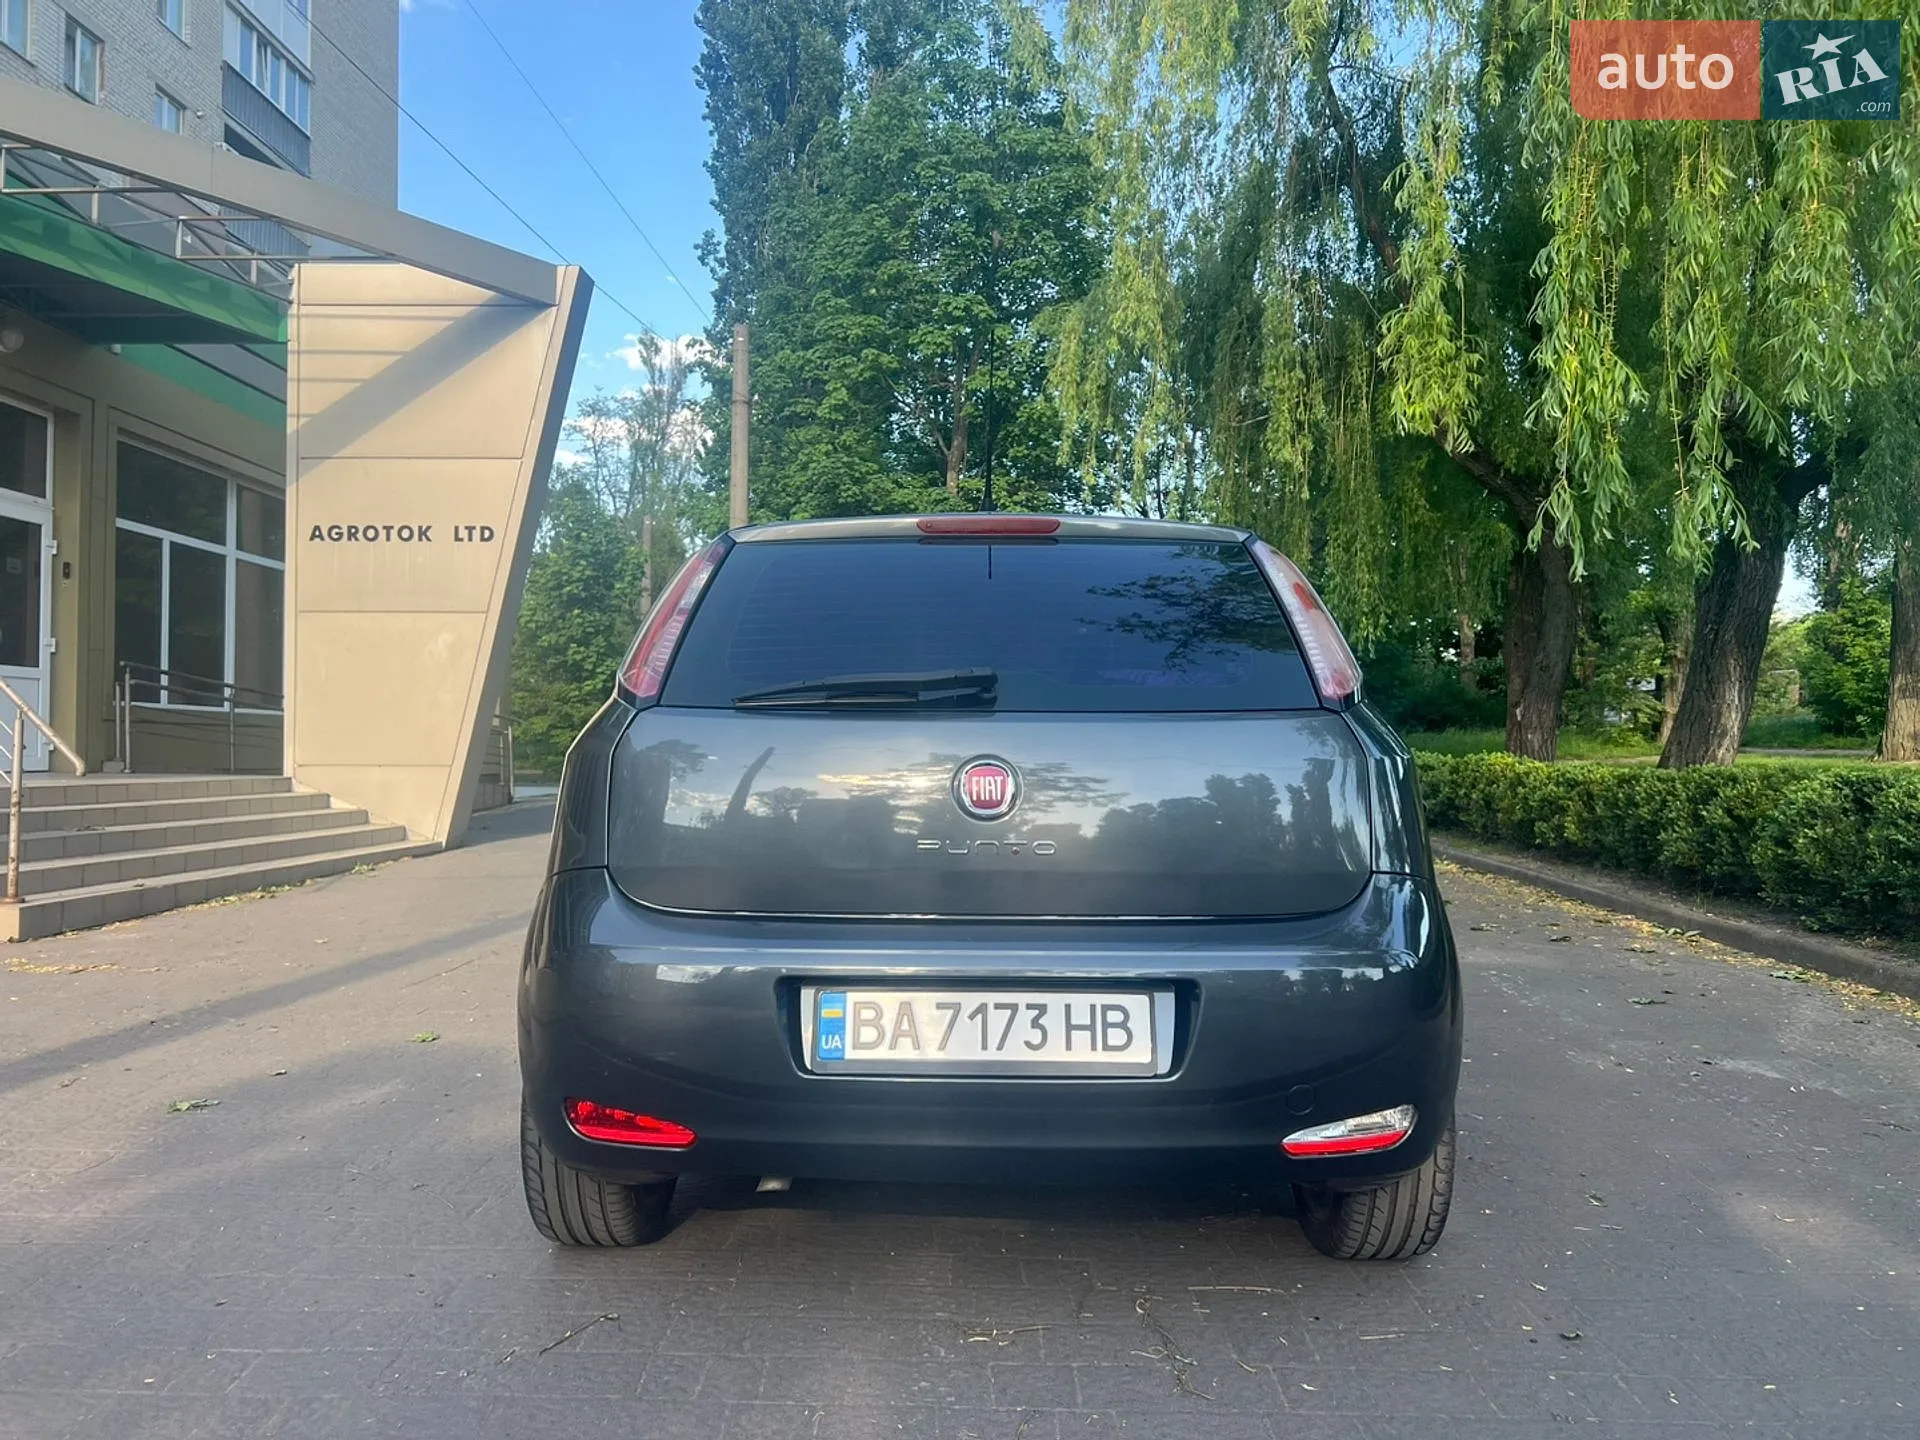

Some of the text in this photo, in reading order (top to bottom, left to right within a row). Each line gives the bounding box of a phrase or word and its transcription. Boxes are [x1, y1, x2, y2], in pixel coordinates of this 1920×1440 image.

[309, 525, 495, 542] AGROTOK LTD
[971, 776, 1003, 801] FIAT
[917, 839, 1057, 855] PUNTO
[852, 1001, 1134, 1052] BA 7173 HB
[821, 1034, 842, 1050] UA
